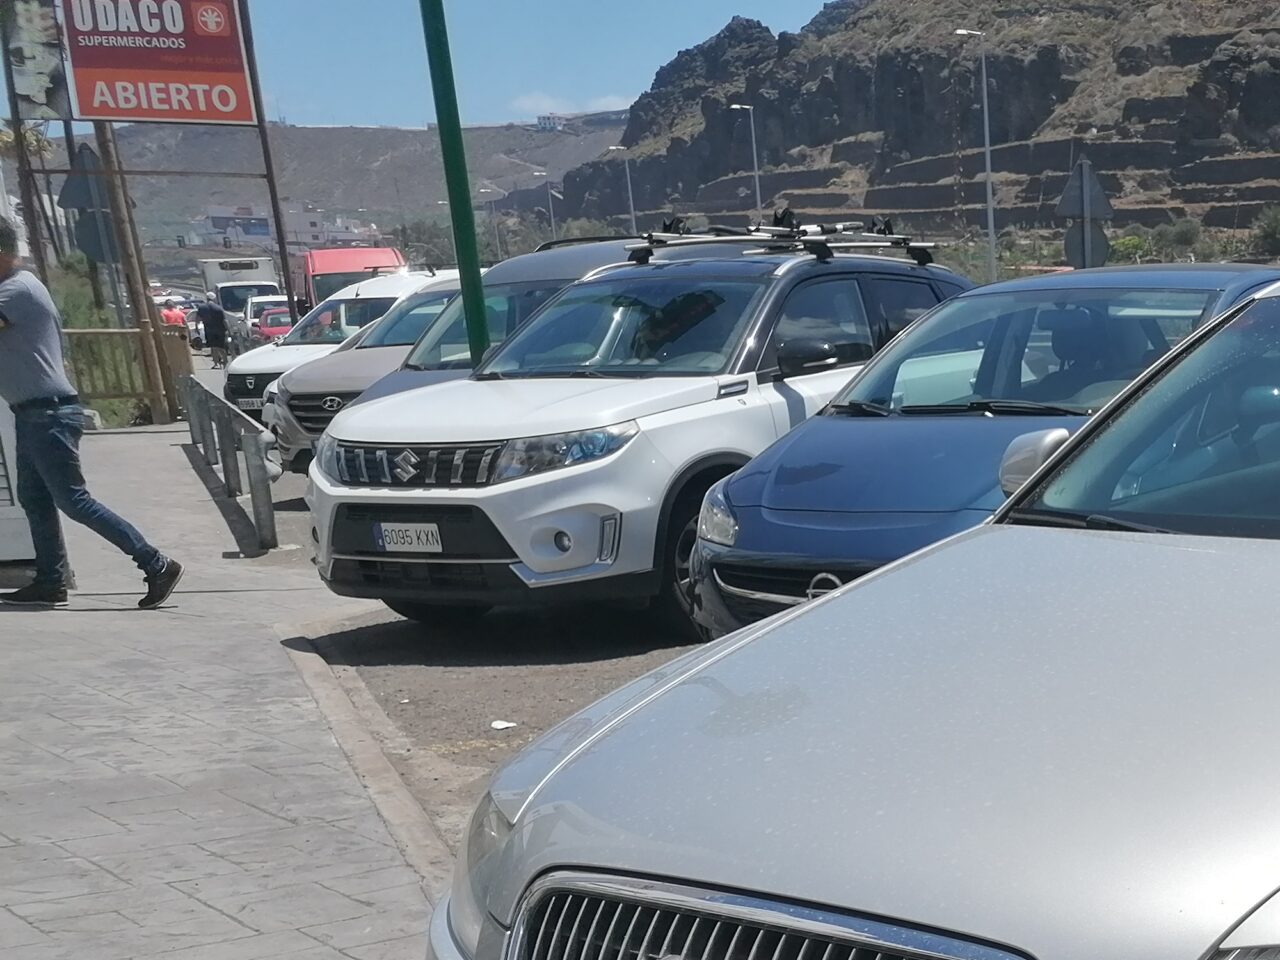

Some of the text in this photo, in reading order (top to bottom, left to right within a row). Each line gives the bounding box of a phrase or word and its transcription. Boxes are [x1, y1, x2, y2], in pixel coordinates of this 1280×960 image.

[71, 0, 185, 34] UDACO
[78, 35, 186, 49] SUPERMERCADOS
[92, 81, 238, 113] ABIERTO
[383, 528, 440, 546] 6095 KXN
